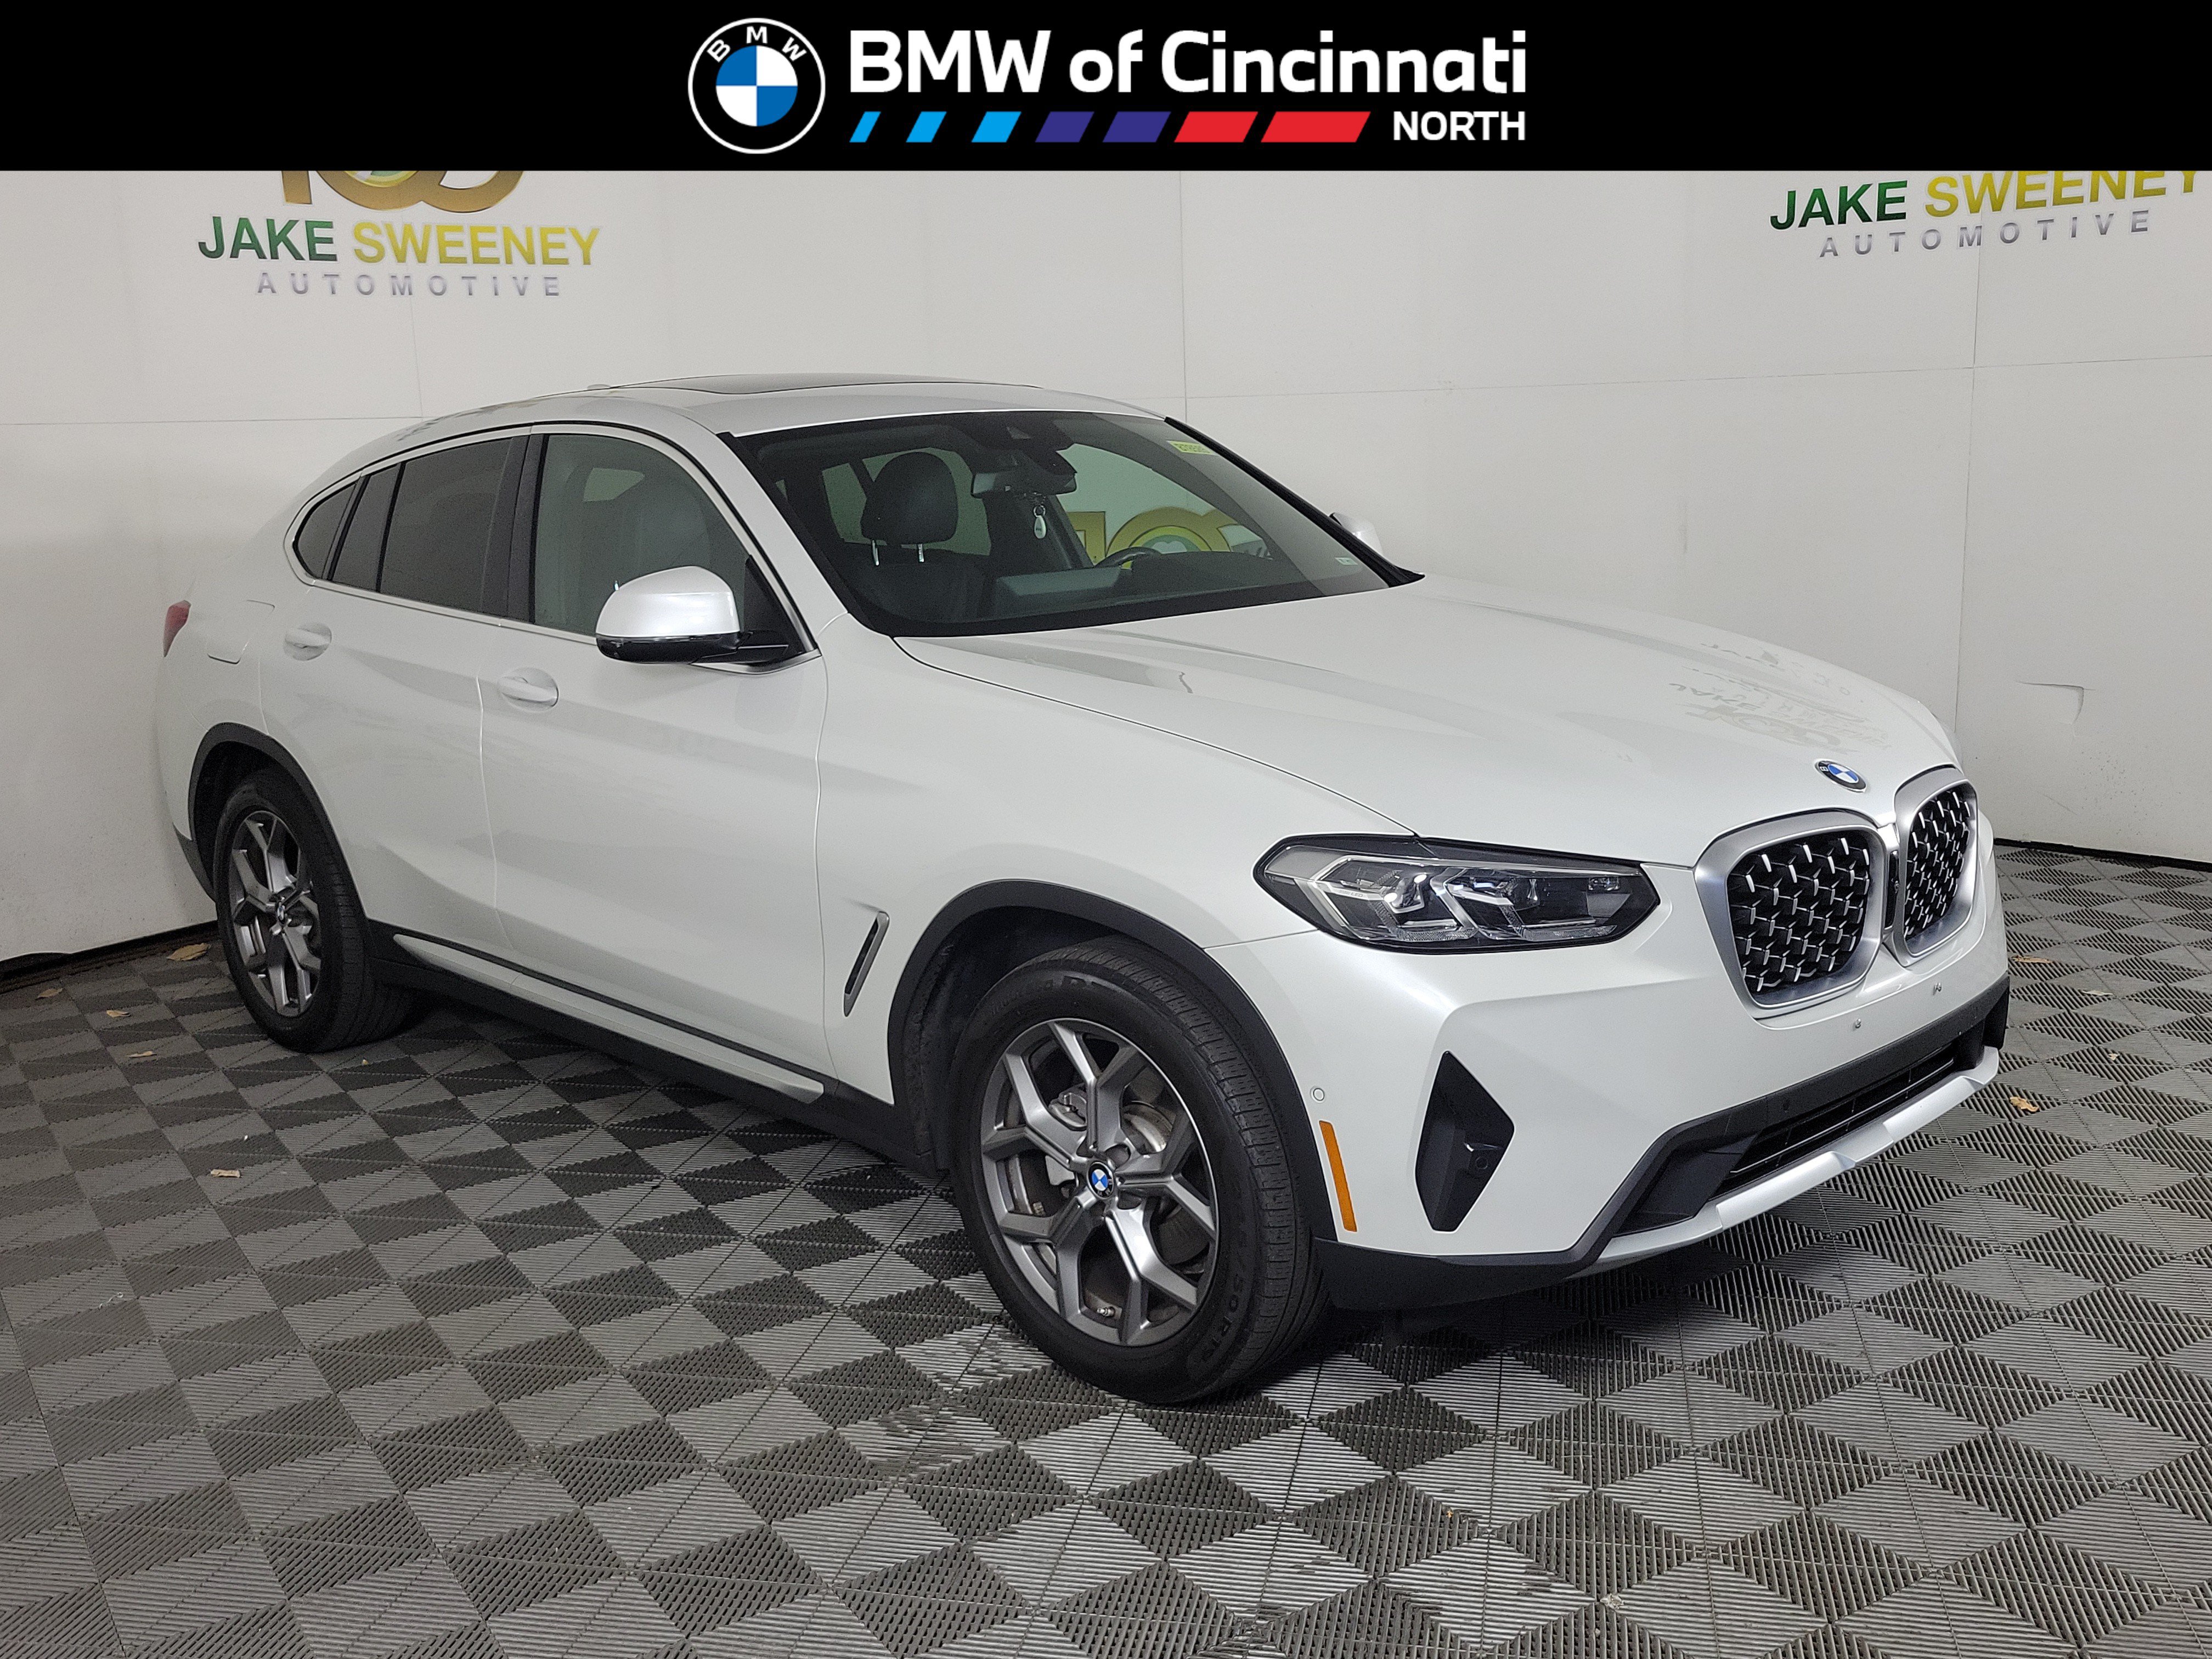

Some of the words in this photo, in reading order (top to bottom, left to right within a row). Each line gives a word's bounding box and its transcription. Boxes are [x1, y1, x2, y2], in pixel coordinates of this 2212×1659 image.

[1770, 180, 1908, 230] JAKE
[198, 216, 337, 262] JAKE
[353, 222, 599, 266] SWEENEY
[1819, 210, 2149, 258] AUTOMOTIVE
[257, 273, 560, 297] AUTOMOTIVE
